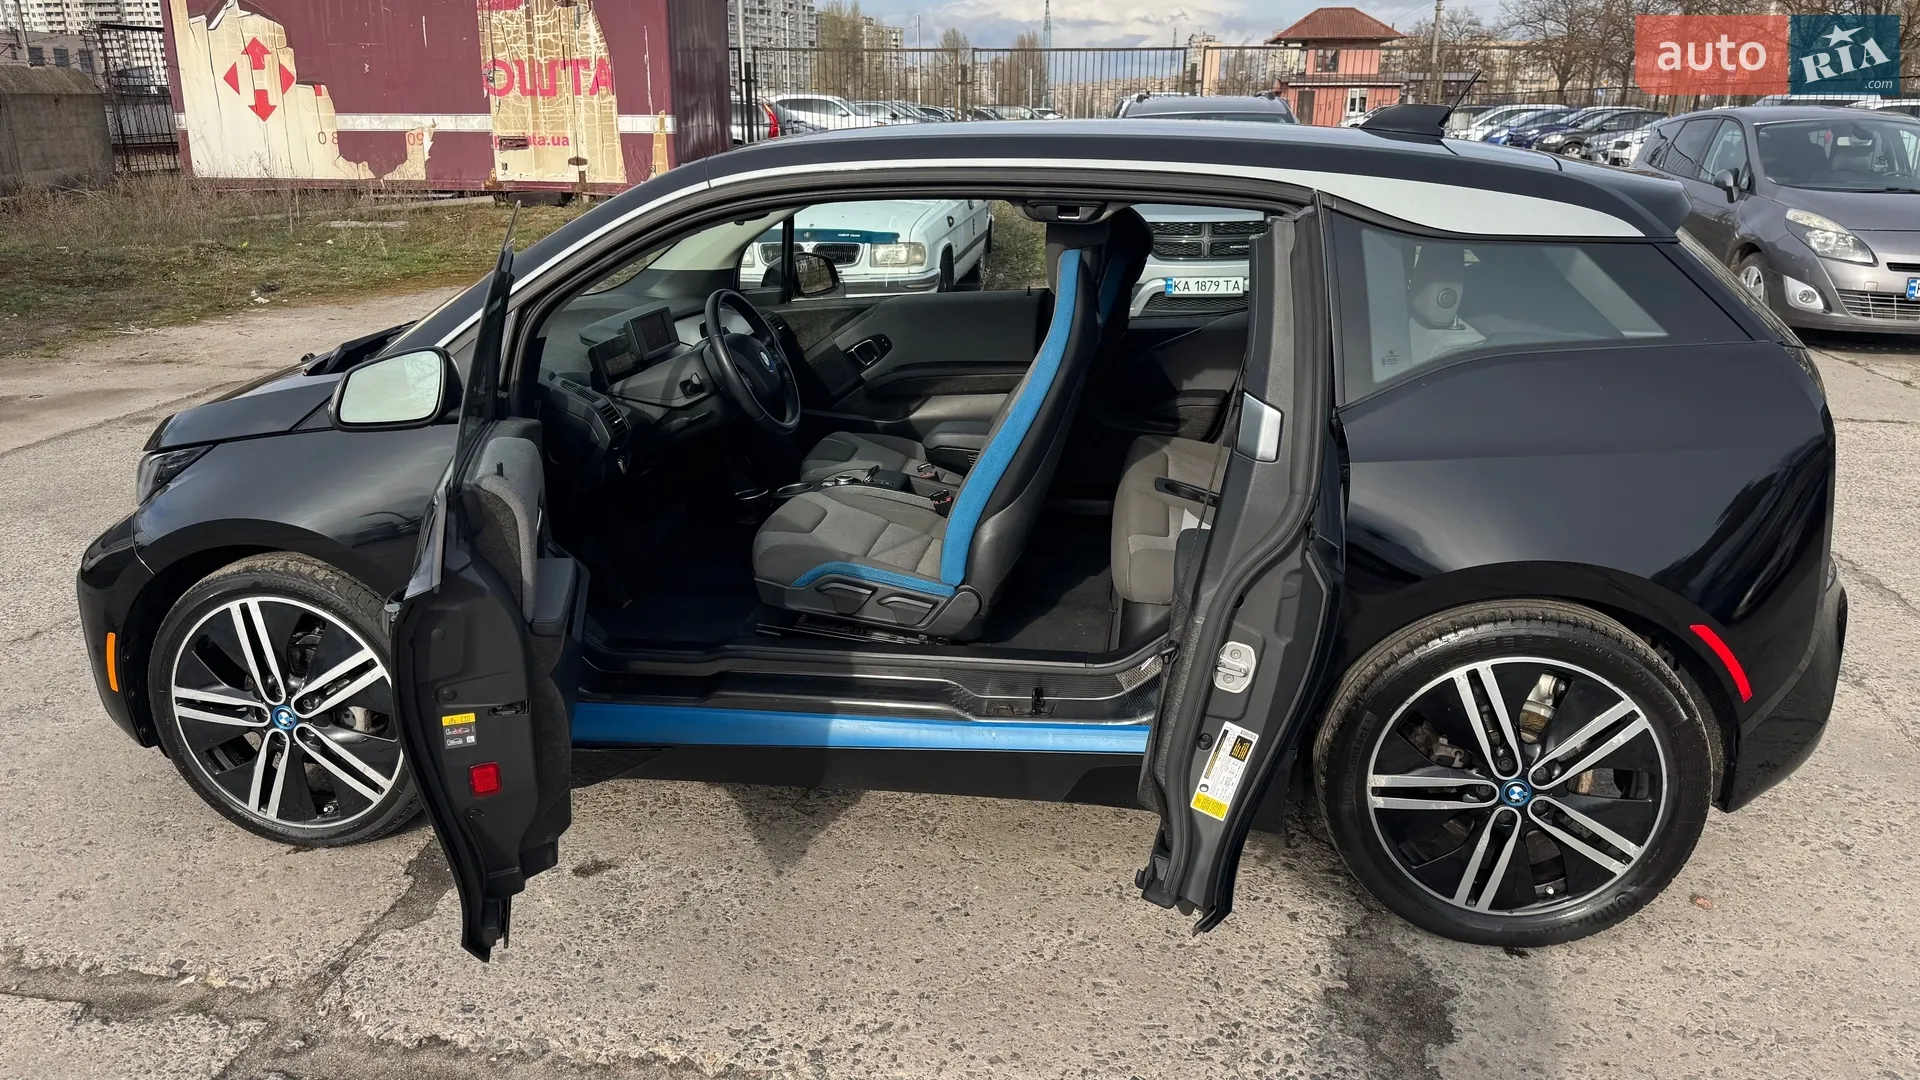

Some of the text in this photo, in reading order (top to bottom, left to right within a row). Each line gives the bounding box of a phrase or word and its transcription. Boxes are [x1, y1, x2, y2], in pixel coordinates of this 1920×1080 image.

[1173, 280, 1240, 292] KA 1879 TA
